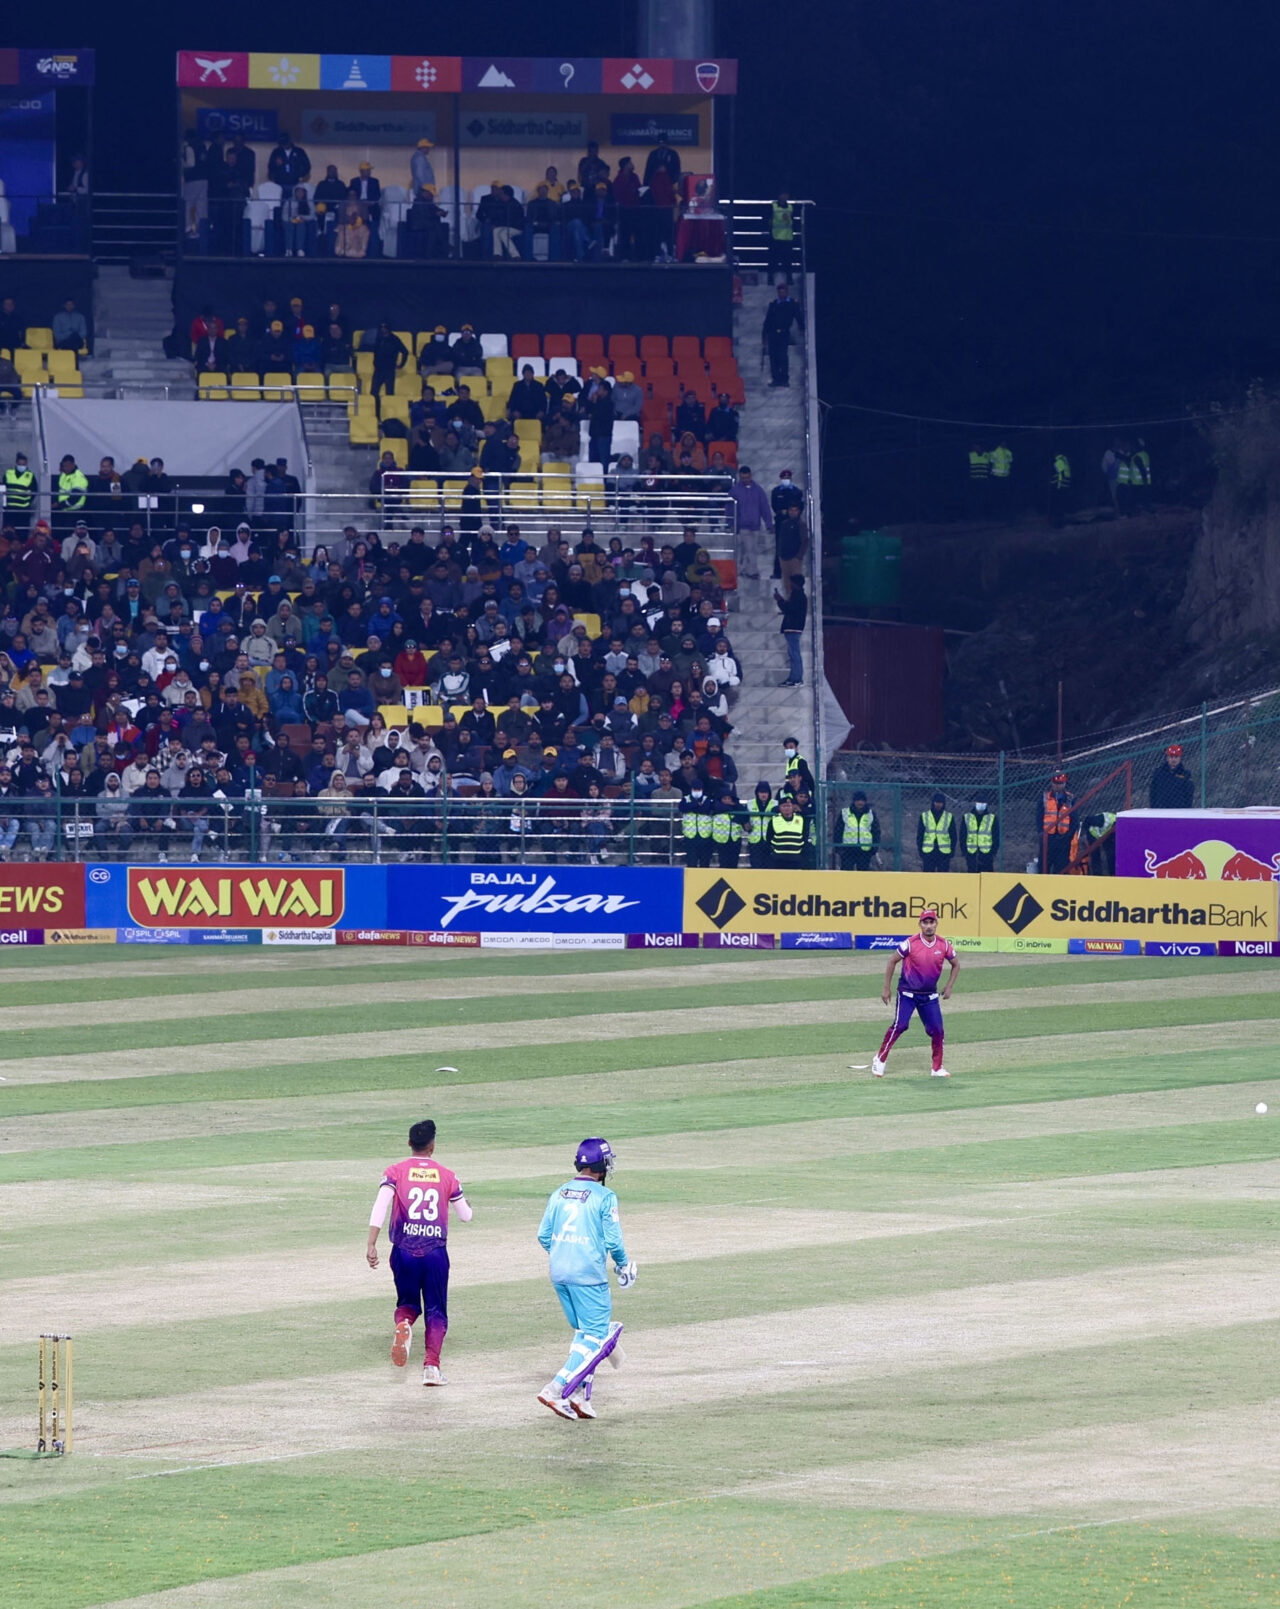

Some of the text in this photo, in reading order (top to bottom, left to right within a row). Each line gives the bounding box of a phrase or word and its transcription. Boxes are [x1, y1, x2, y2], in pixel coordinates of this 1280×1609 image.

[228, 115, 269, 131] SPIL
[471, 873, 537, 885] BAJAJ
[0, 886, 64, 912] EWS
[137, 877, 333, 917] WAI WAI
[440, 875, 640, 928] pulsar
[644, 933, 683, 946] Ncell
[720, 933, 758, 946] Ncell
[955, 939, 982, 947] inDrive
[1025, 941, 1052, 949] inDrive
[1086, 942, 1122, 951] WAI WAI
[1159, 942, 1201, 955] vivo
[1235, 941, 1273, 954] Ncell
[408, 1187, 439, 1221] 23
[563, 1203, 578, 1232] 2
[403, 1222, 442, 1238] KISHOR
